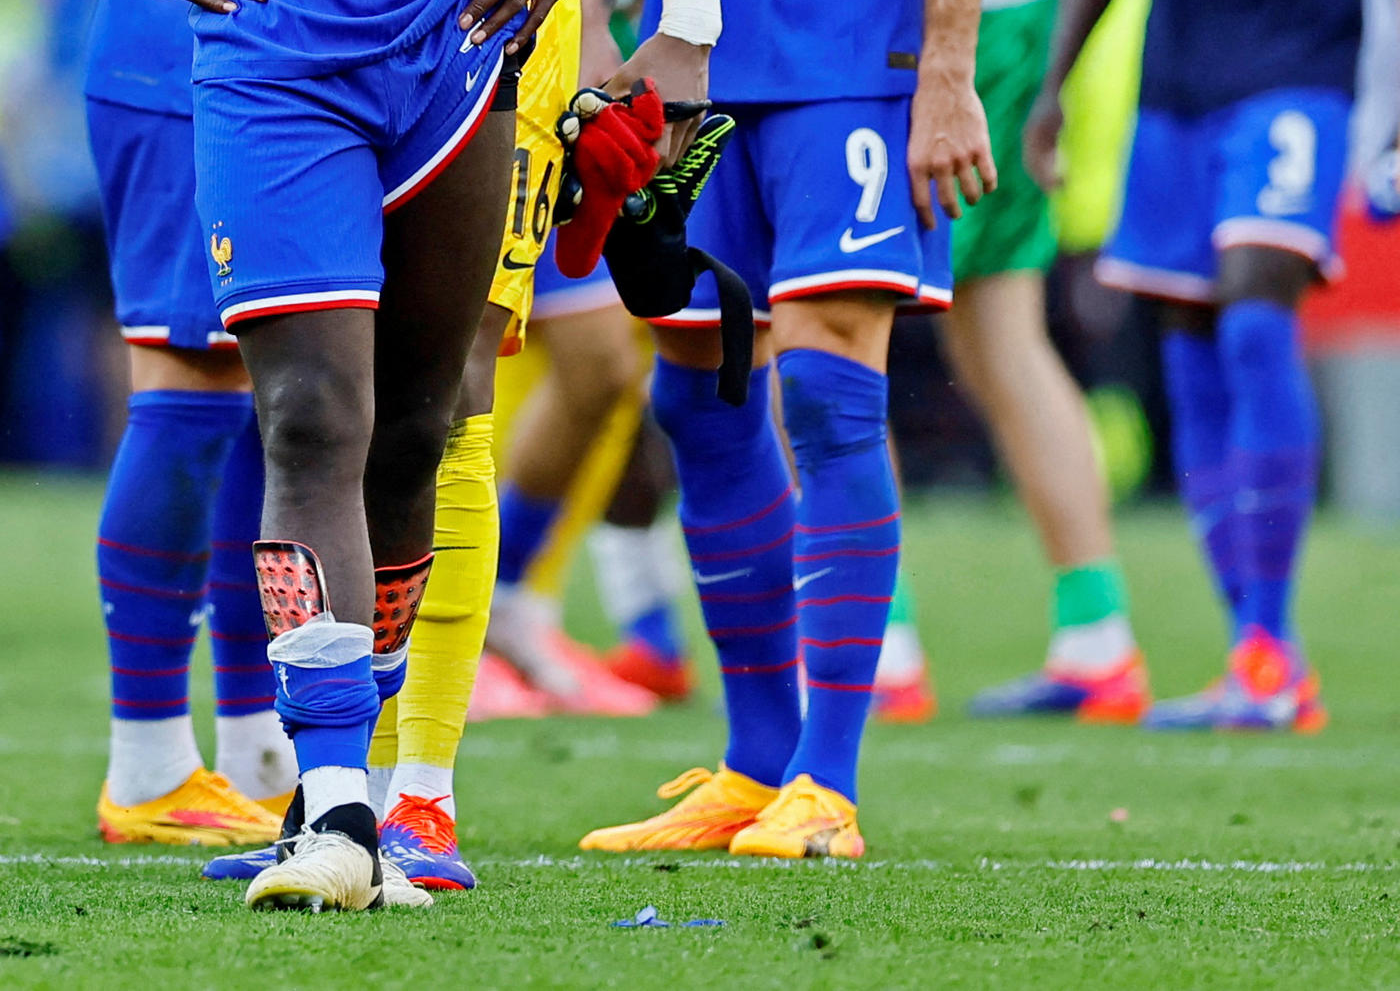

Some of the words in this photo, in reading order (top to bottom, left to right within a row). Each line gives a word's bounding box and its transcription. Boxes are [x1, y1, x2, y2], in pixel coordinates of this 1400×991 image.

[512, 147, 555, 247] 16
[845, 127, 888, 223] 9
[1267, 109, 1316, 194] 3
